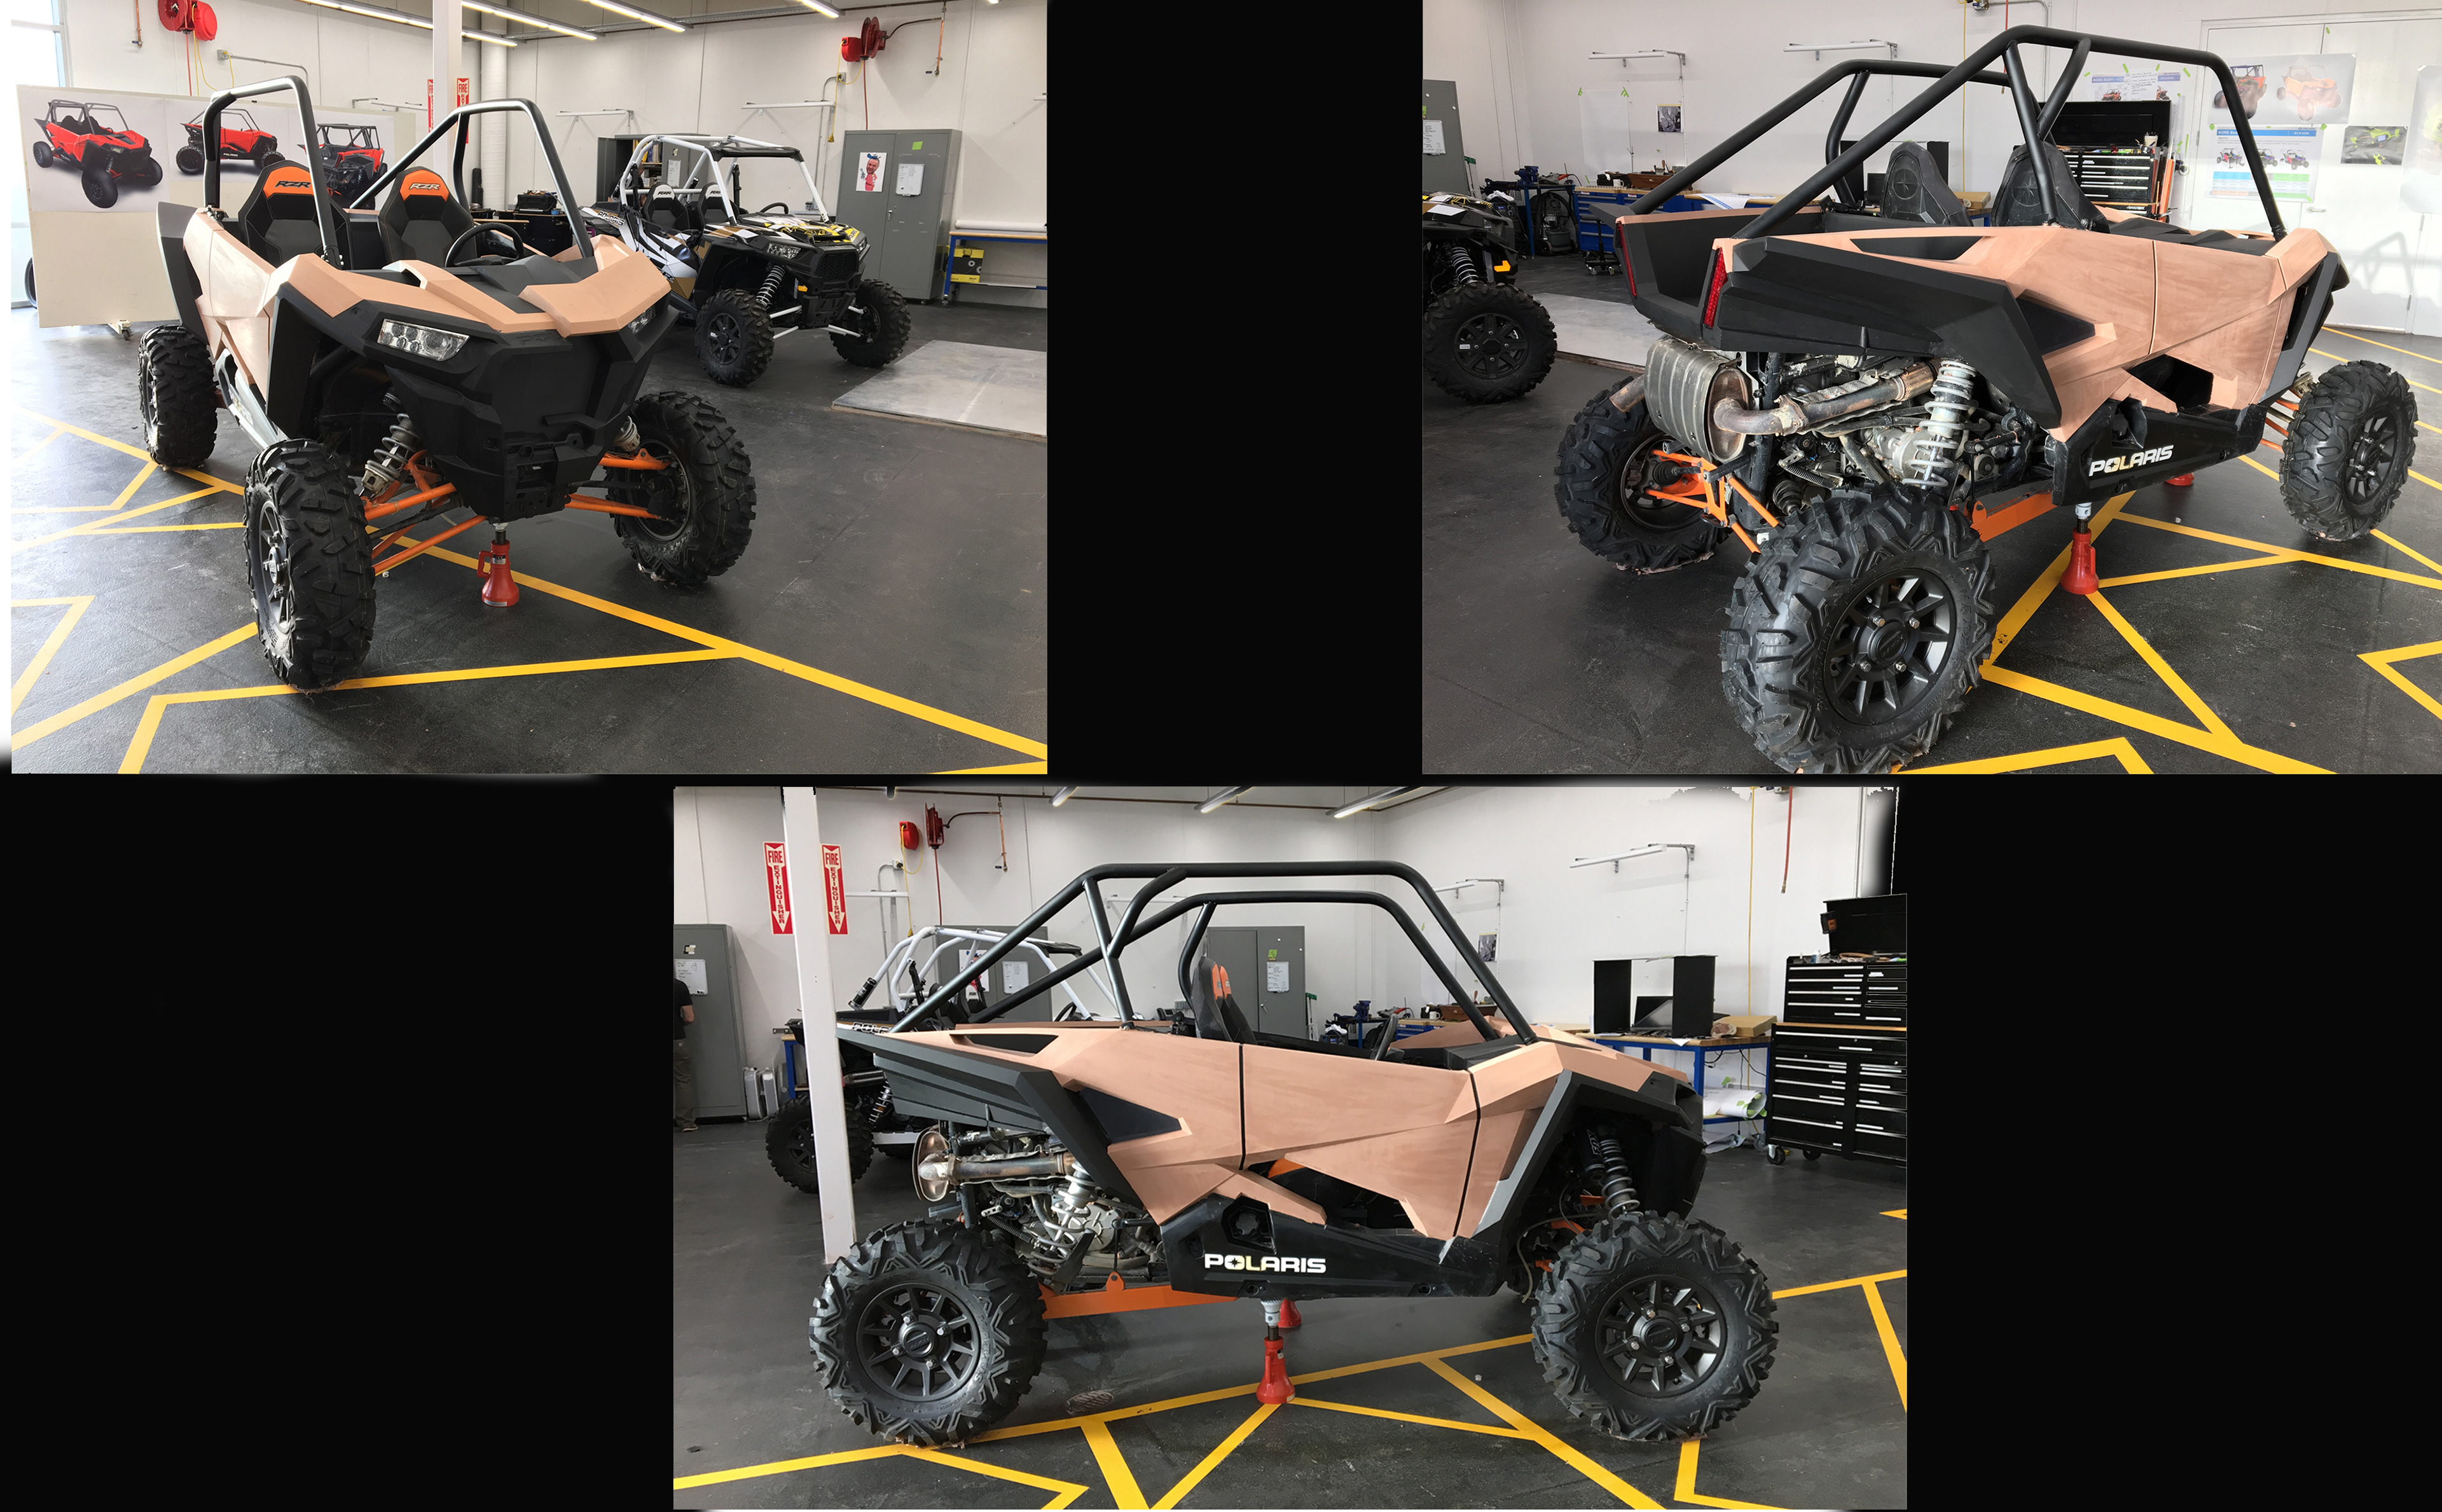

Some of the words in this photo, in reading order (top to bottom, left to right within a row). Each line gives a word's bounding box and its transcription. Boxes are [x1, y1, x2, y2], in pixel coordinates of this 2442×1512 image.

[459, 83, 467, 93] FIRE
[409, 182, 441, 191] RZR
[598, 210, 626, 226] POLARIS
[2088, 445, 2174, 477] POLARIS
[768, 851, 783, 863] FIRE
[825, 853, 839, 865] FIRE
[773, 865, 785, 924] EXTINGUISHER
[831, 867, 841, 924] EXTINGUISHER
[1204, 1253, 1327, 1274] POLARIS
